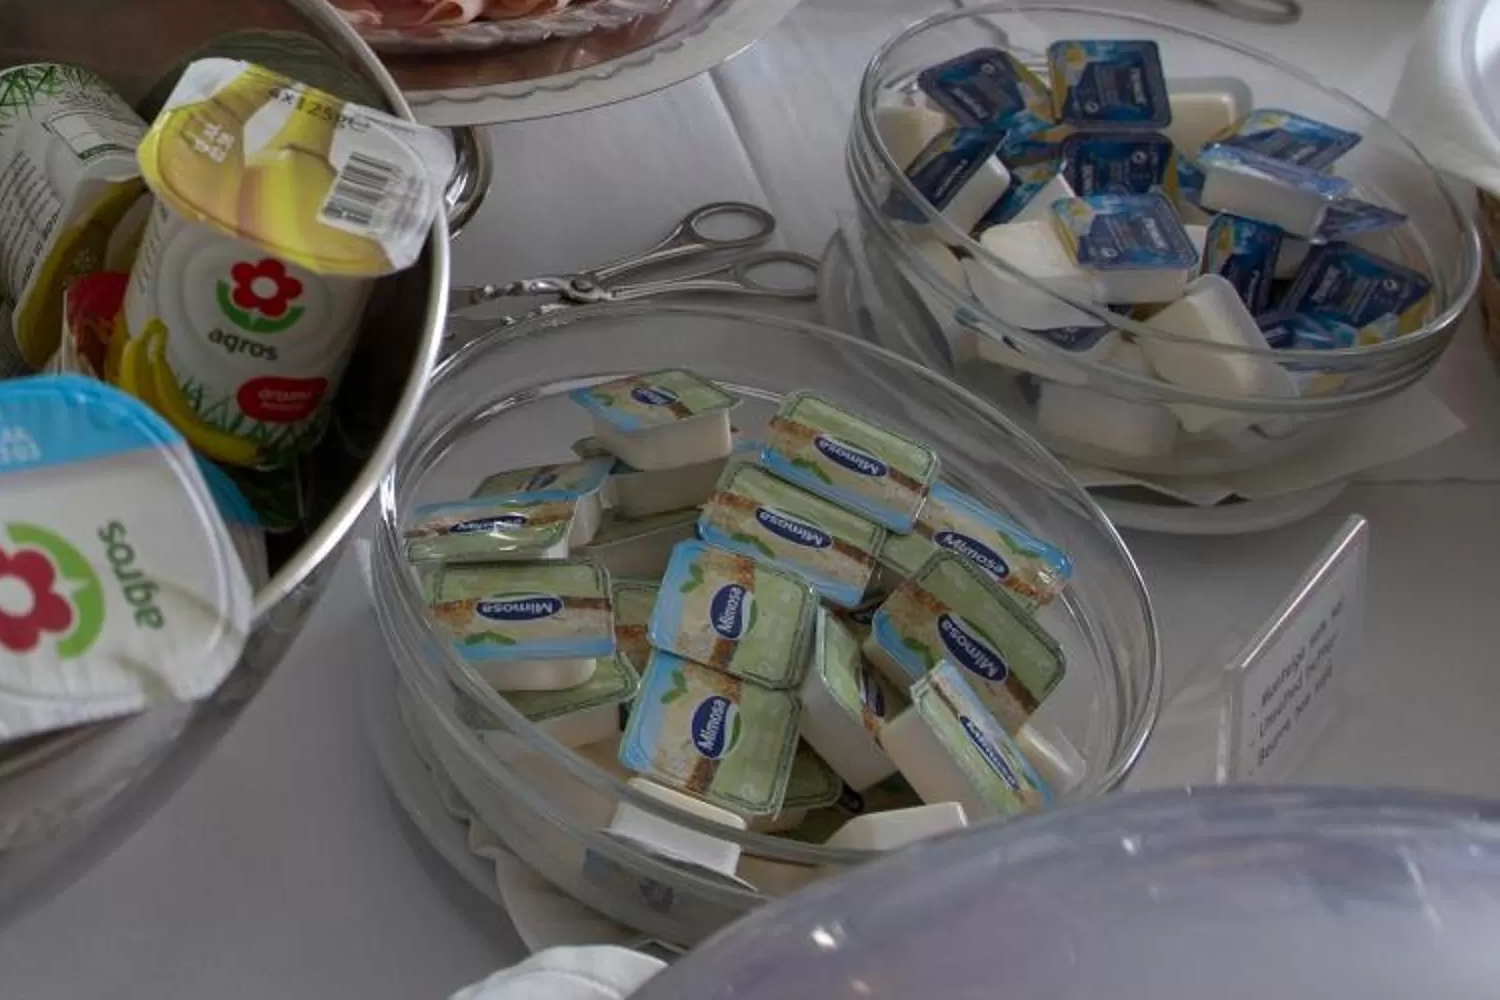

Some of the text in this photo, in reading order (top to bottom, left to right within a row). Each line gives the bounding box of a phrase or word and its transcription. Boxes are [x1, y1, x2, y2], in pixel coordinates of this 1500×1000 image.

[207, 327, 278, 361] agros
[818, 438, 880, 476] Mimosa
[758, 510, 824, 548] Mimosa
[941, 533, 1006, 575] Mimosa
[97, 520, 164, 631] agros
[481, 599, 554, 615] Mimosa
[715, 586, 743, 633] Mimosa
[940, 617, 1000, 679] Mimosa
[696, 699, 726, 751] Mimosa
